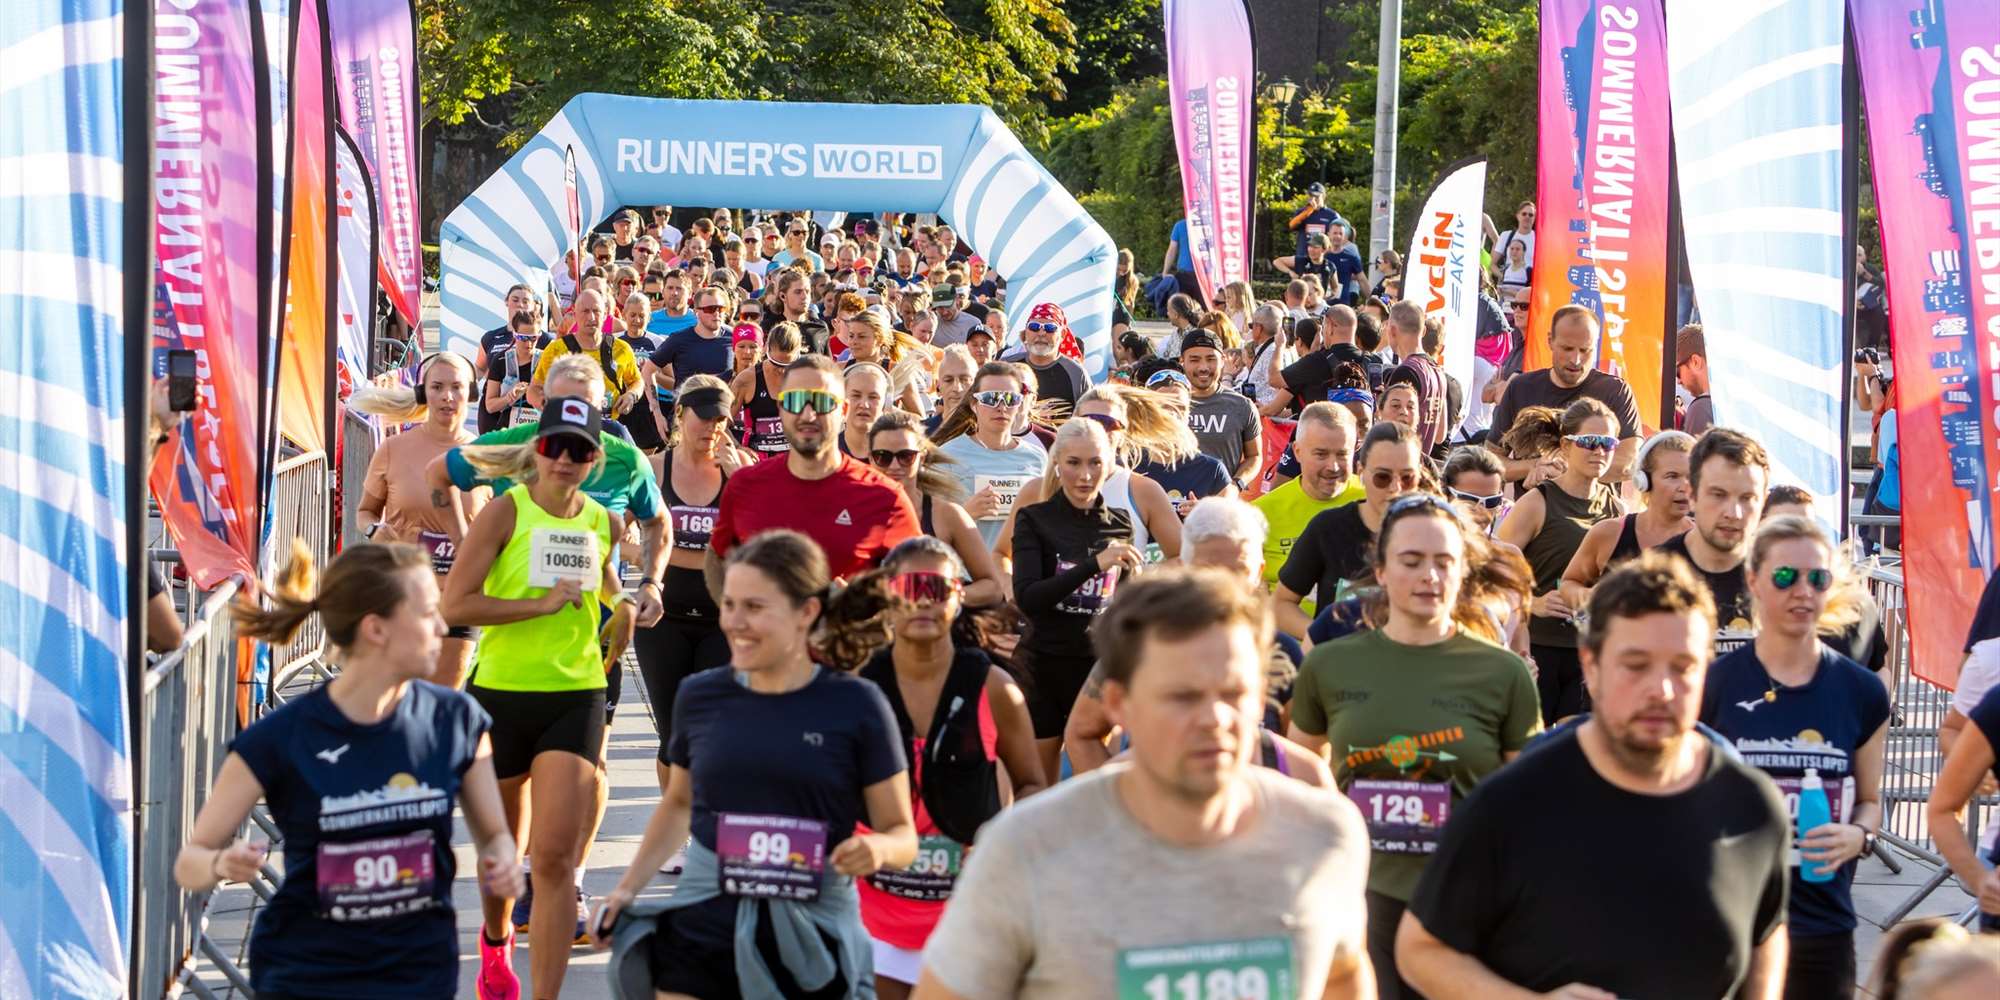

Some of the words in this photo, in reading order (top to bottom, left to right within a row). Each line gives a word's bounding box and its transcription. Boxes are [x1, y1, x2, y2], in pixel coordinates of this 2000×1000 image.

[617, 138, 807, 177] RUNNER'S
[822, 150, 937, 174] WORLD
[680, 515, 714, 534] 169
[545, 552, 591, 569] 100369
[1369, 793, 1424, 824] 129
[748, 831, 790, 866] 99
[354, 855, 397, 889] 90
[1144, 966, 1268, 1000] 1189
